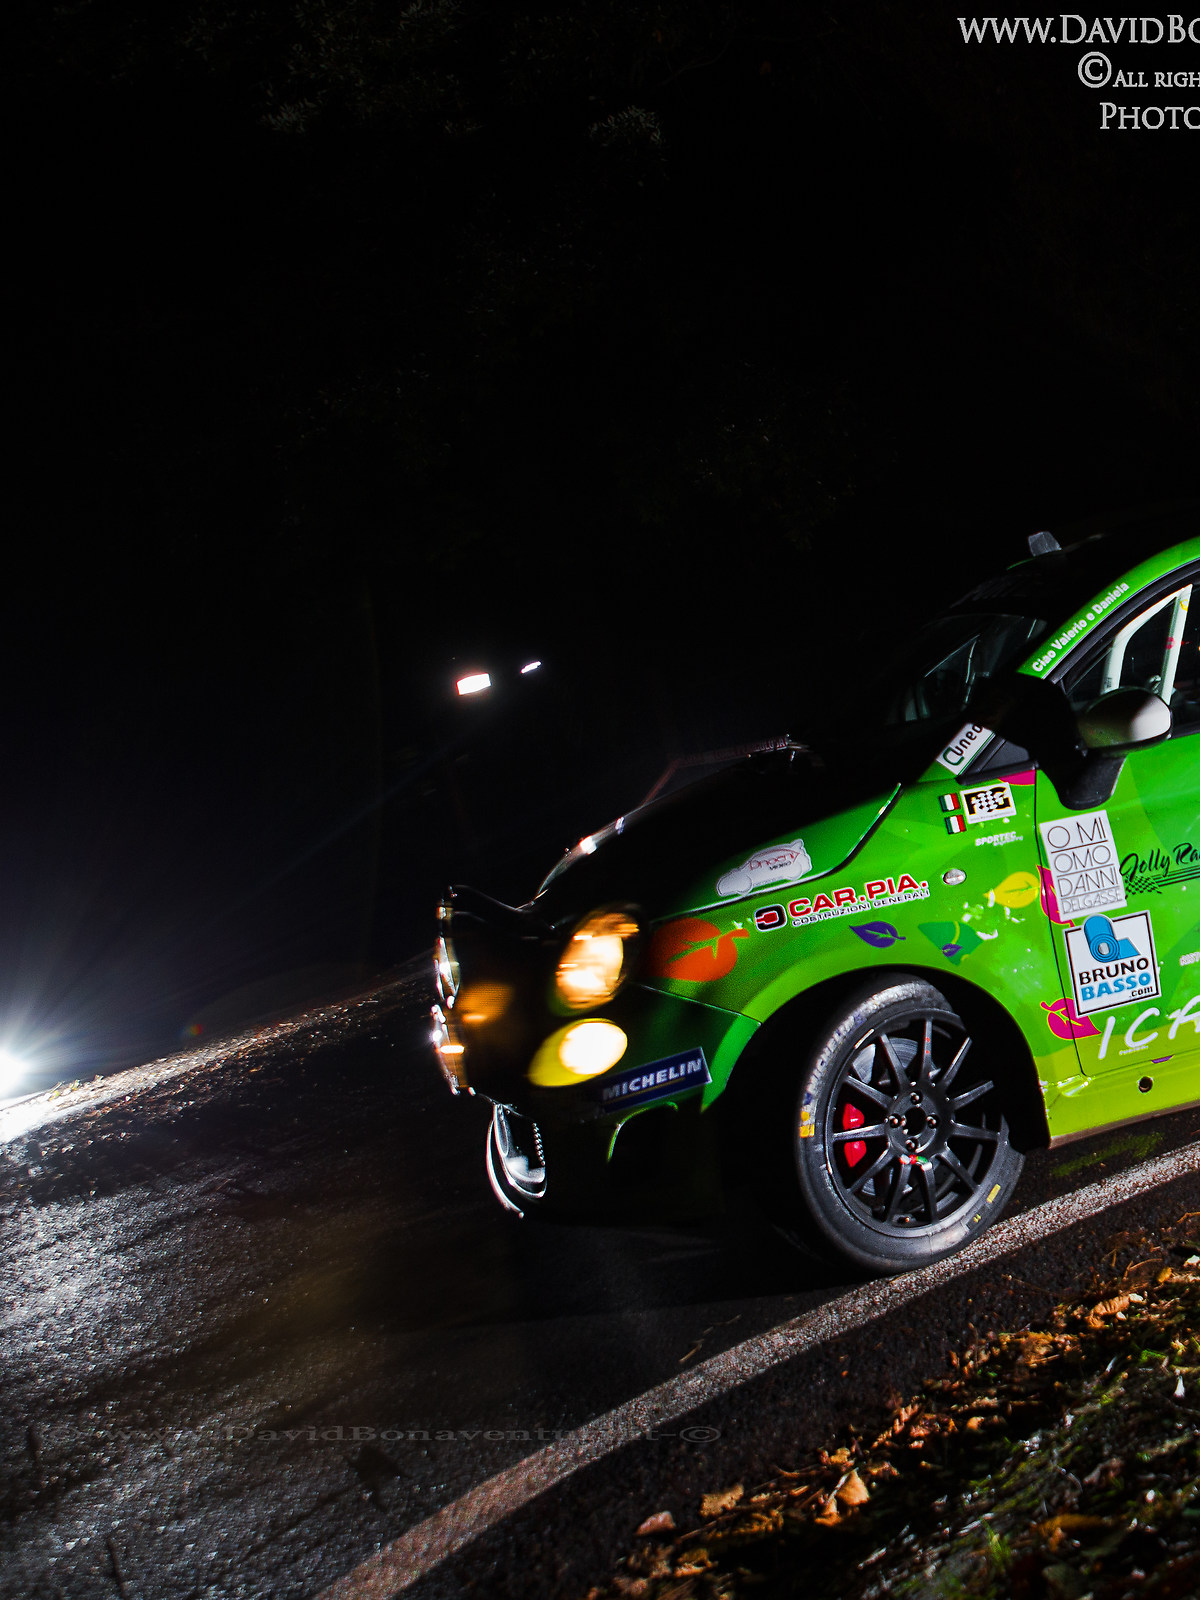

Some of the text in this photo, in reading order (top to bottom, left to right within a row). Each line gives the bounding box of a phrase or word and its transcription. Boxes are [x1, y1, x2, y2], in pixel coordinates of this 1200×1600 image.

[1032, 650, 1056, 672] Ciao
[1051, 619, 1088, 650] Valerio
[1092, 582, 1130, 614] Daniela
[1047, 817, 1106, 849] O MI
[1054, 845, 1111, 873] OMO
[1119, 848, 1171, 882] Jolly
[1057, 866, 1118, 898] DANNI
[792, 889, 930, 927] COSTRUZIONI GENERALI
[1061, 889, 1123, 915] DELGASSE
[1079, 957, 1149, 986] BRUNO
[1081, 972, 1151, 1002] BASSO
[1129, 986, 1153, 998] .com
[603, 1059, 702, 1100] MICHELIN
